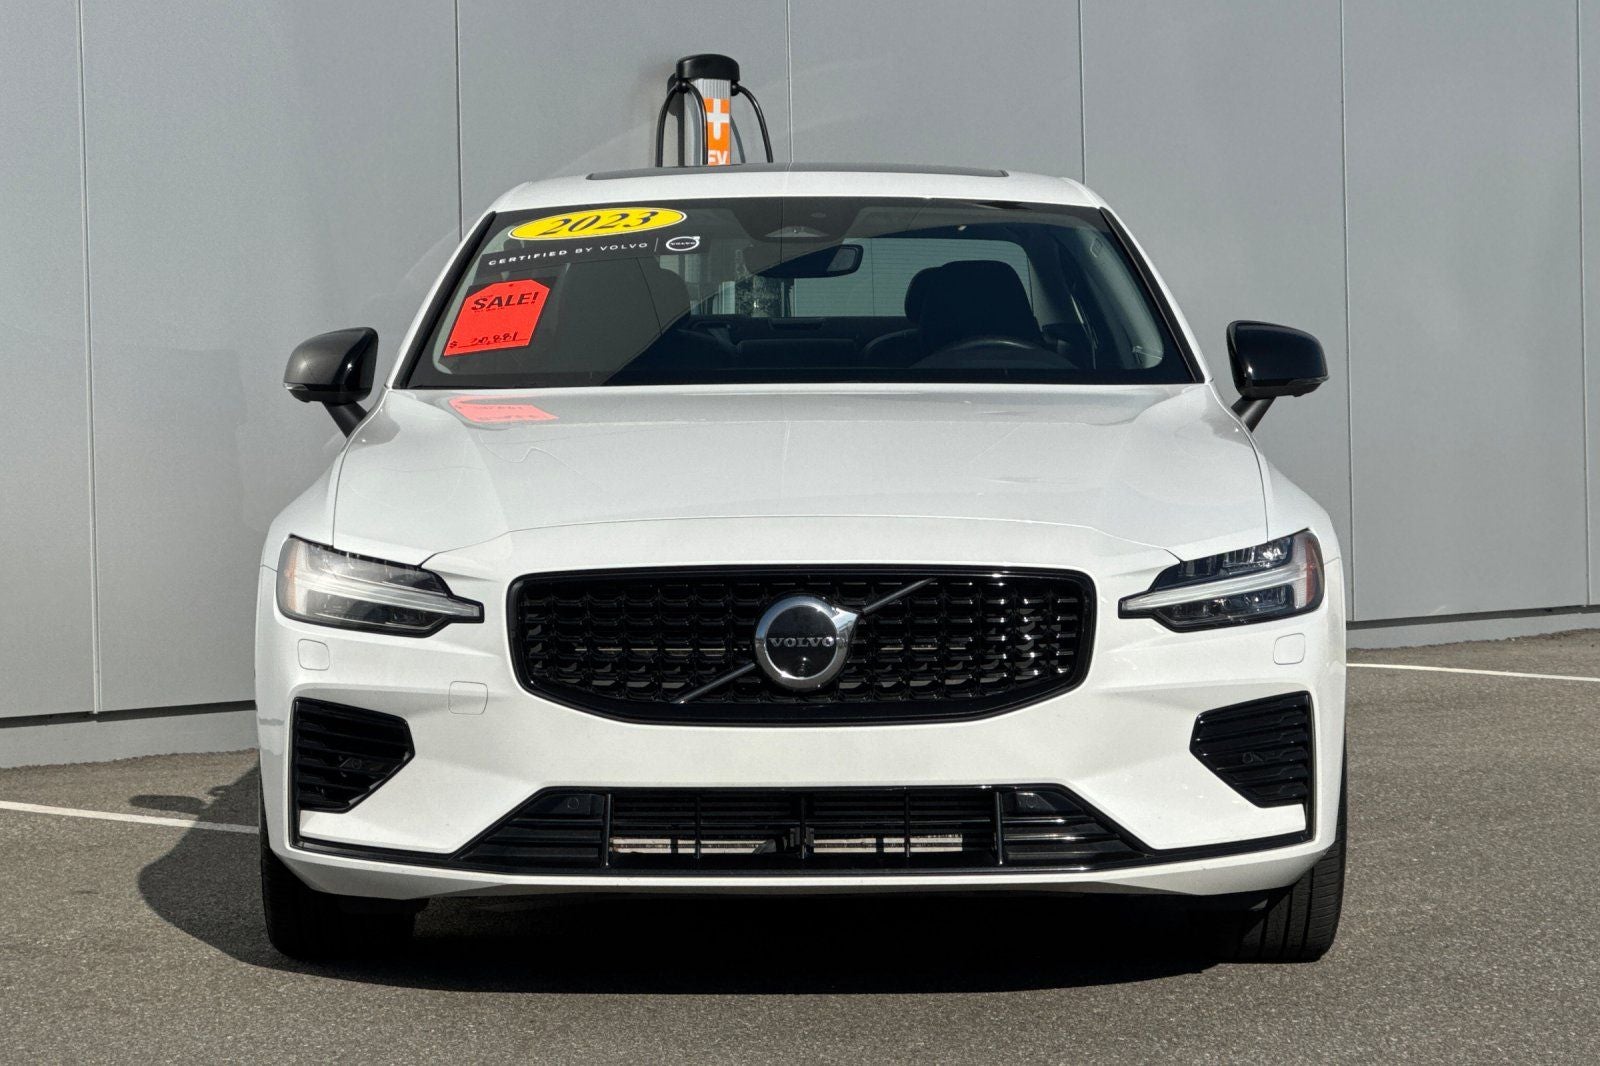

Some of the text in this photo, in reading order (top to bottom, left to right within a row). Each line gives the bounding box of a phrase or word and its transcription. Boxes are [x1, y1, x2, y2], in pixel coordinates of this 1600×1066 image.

[535, 210, 659, 237] 2023
[488, 249, 568, 266] CERTIFIED
[600, 242, 648, 251] VOLVO
[471, 292, 539, 311] SALE!
[768, 637, 835, 648] VOLVO
